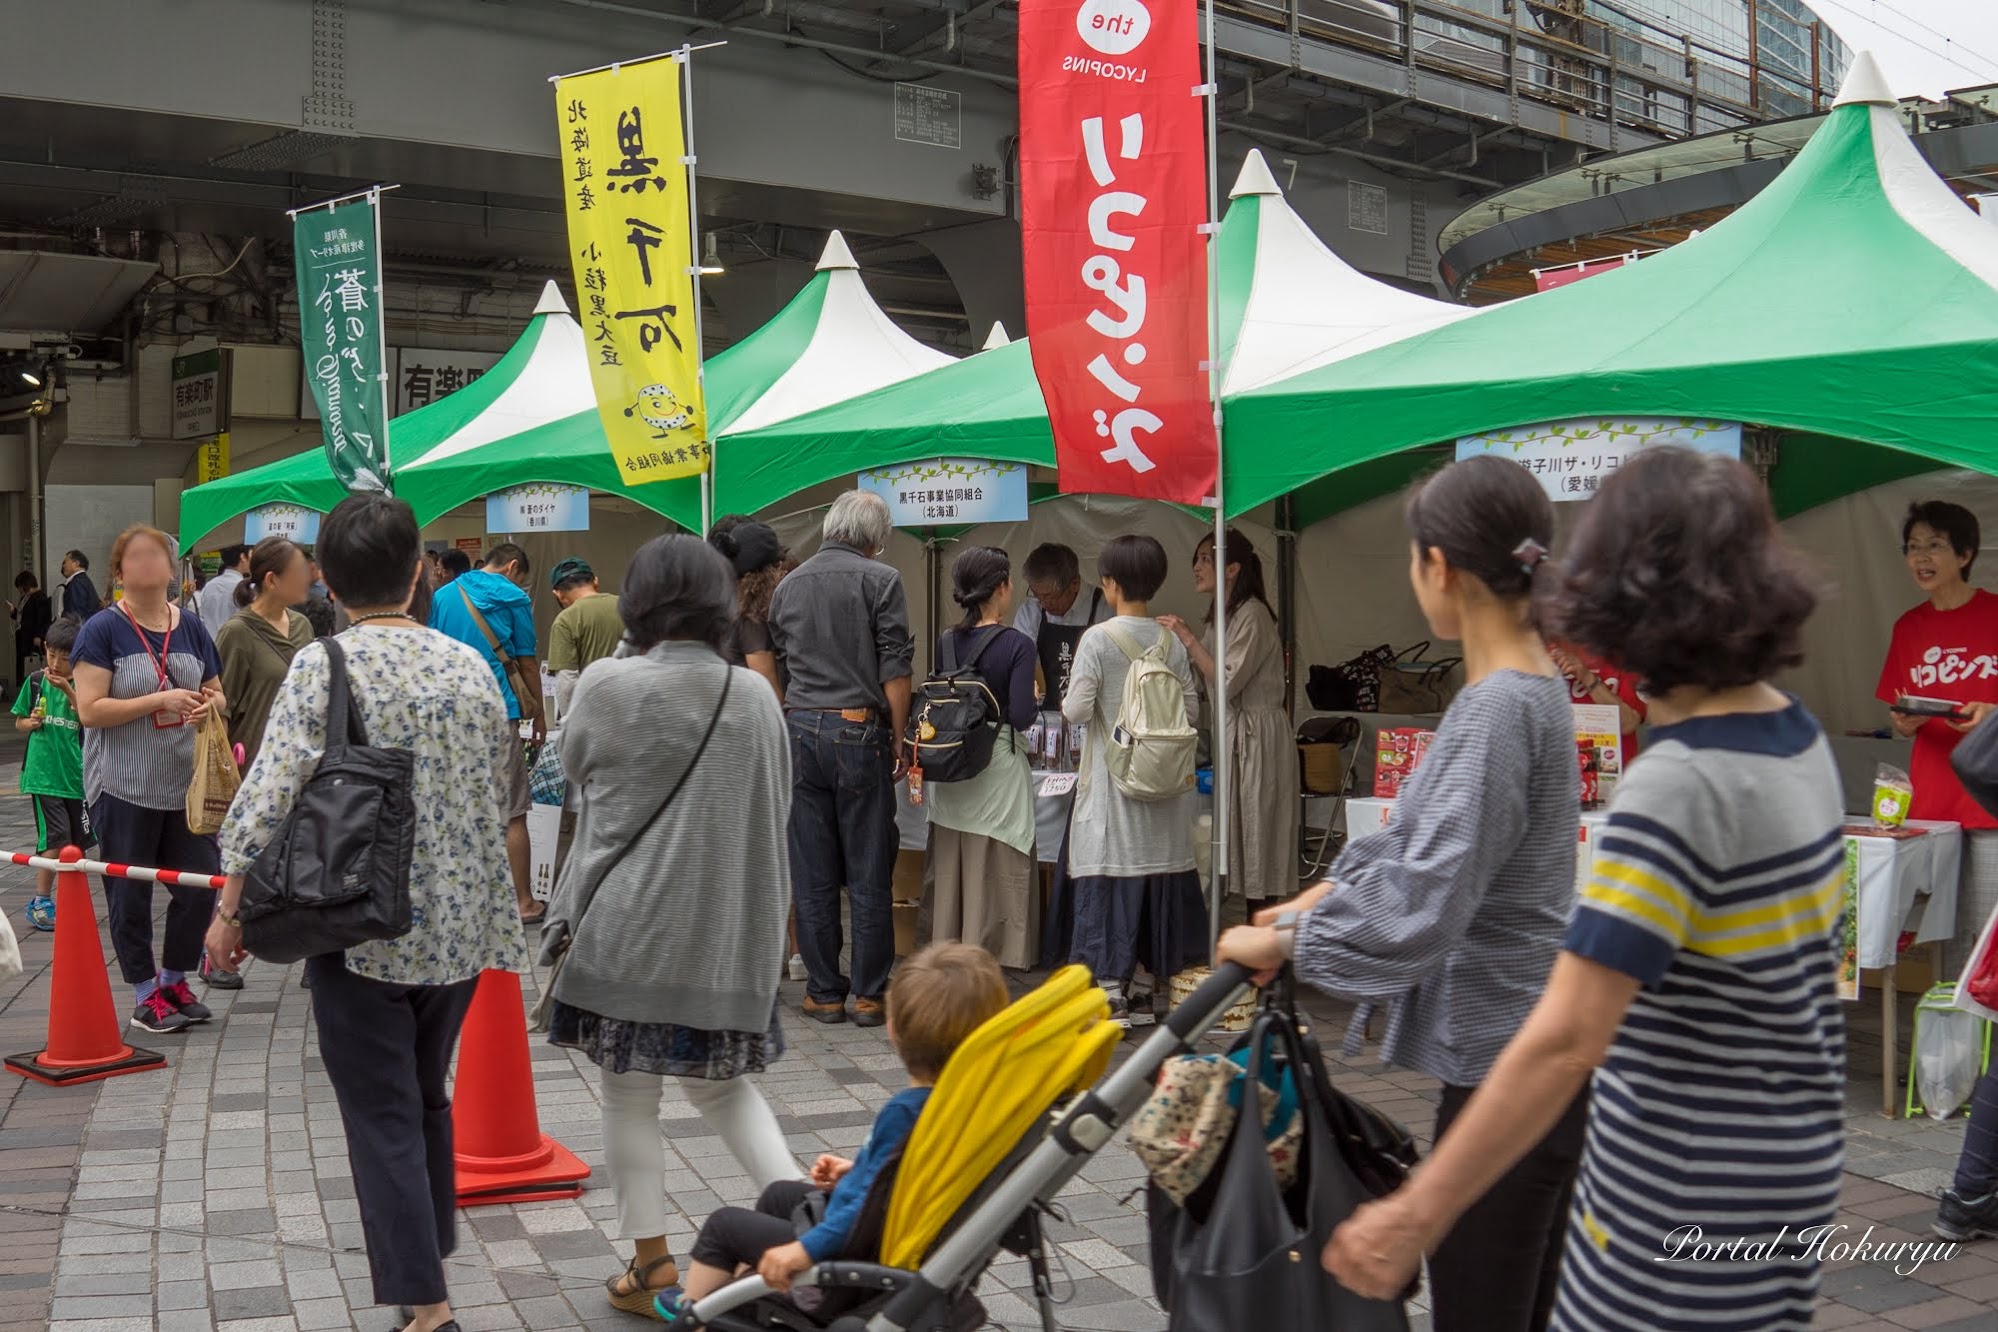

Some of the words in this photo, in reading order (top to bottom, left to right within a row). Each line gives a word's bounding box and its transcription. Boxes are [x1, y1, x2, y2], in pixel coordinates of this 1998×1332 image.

[176, 377, 213, 408] 有楽町駅
[1518, 453, 1628, 475] 遊子川ザ・リコ
[1560, 475, 1601, 493] （愛媛
[900, 487, 983, 504] 黒千石事業協同組合
[922, 505, 959, 518] （北海道）
[1909, 654, 1998, 689] リコピンズ
